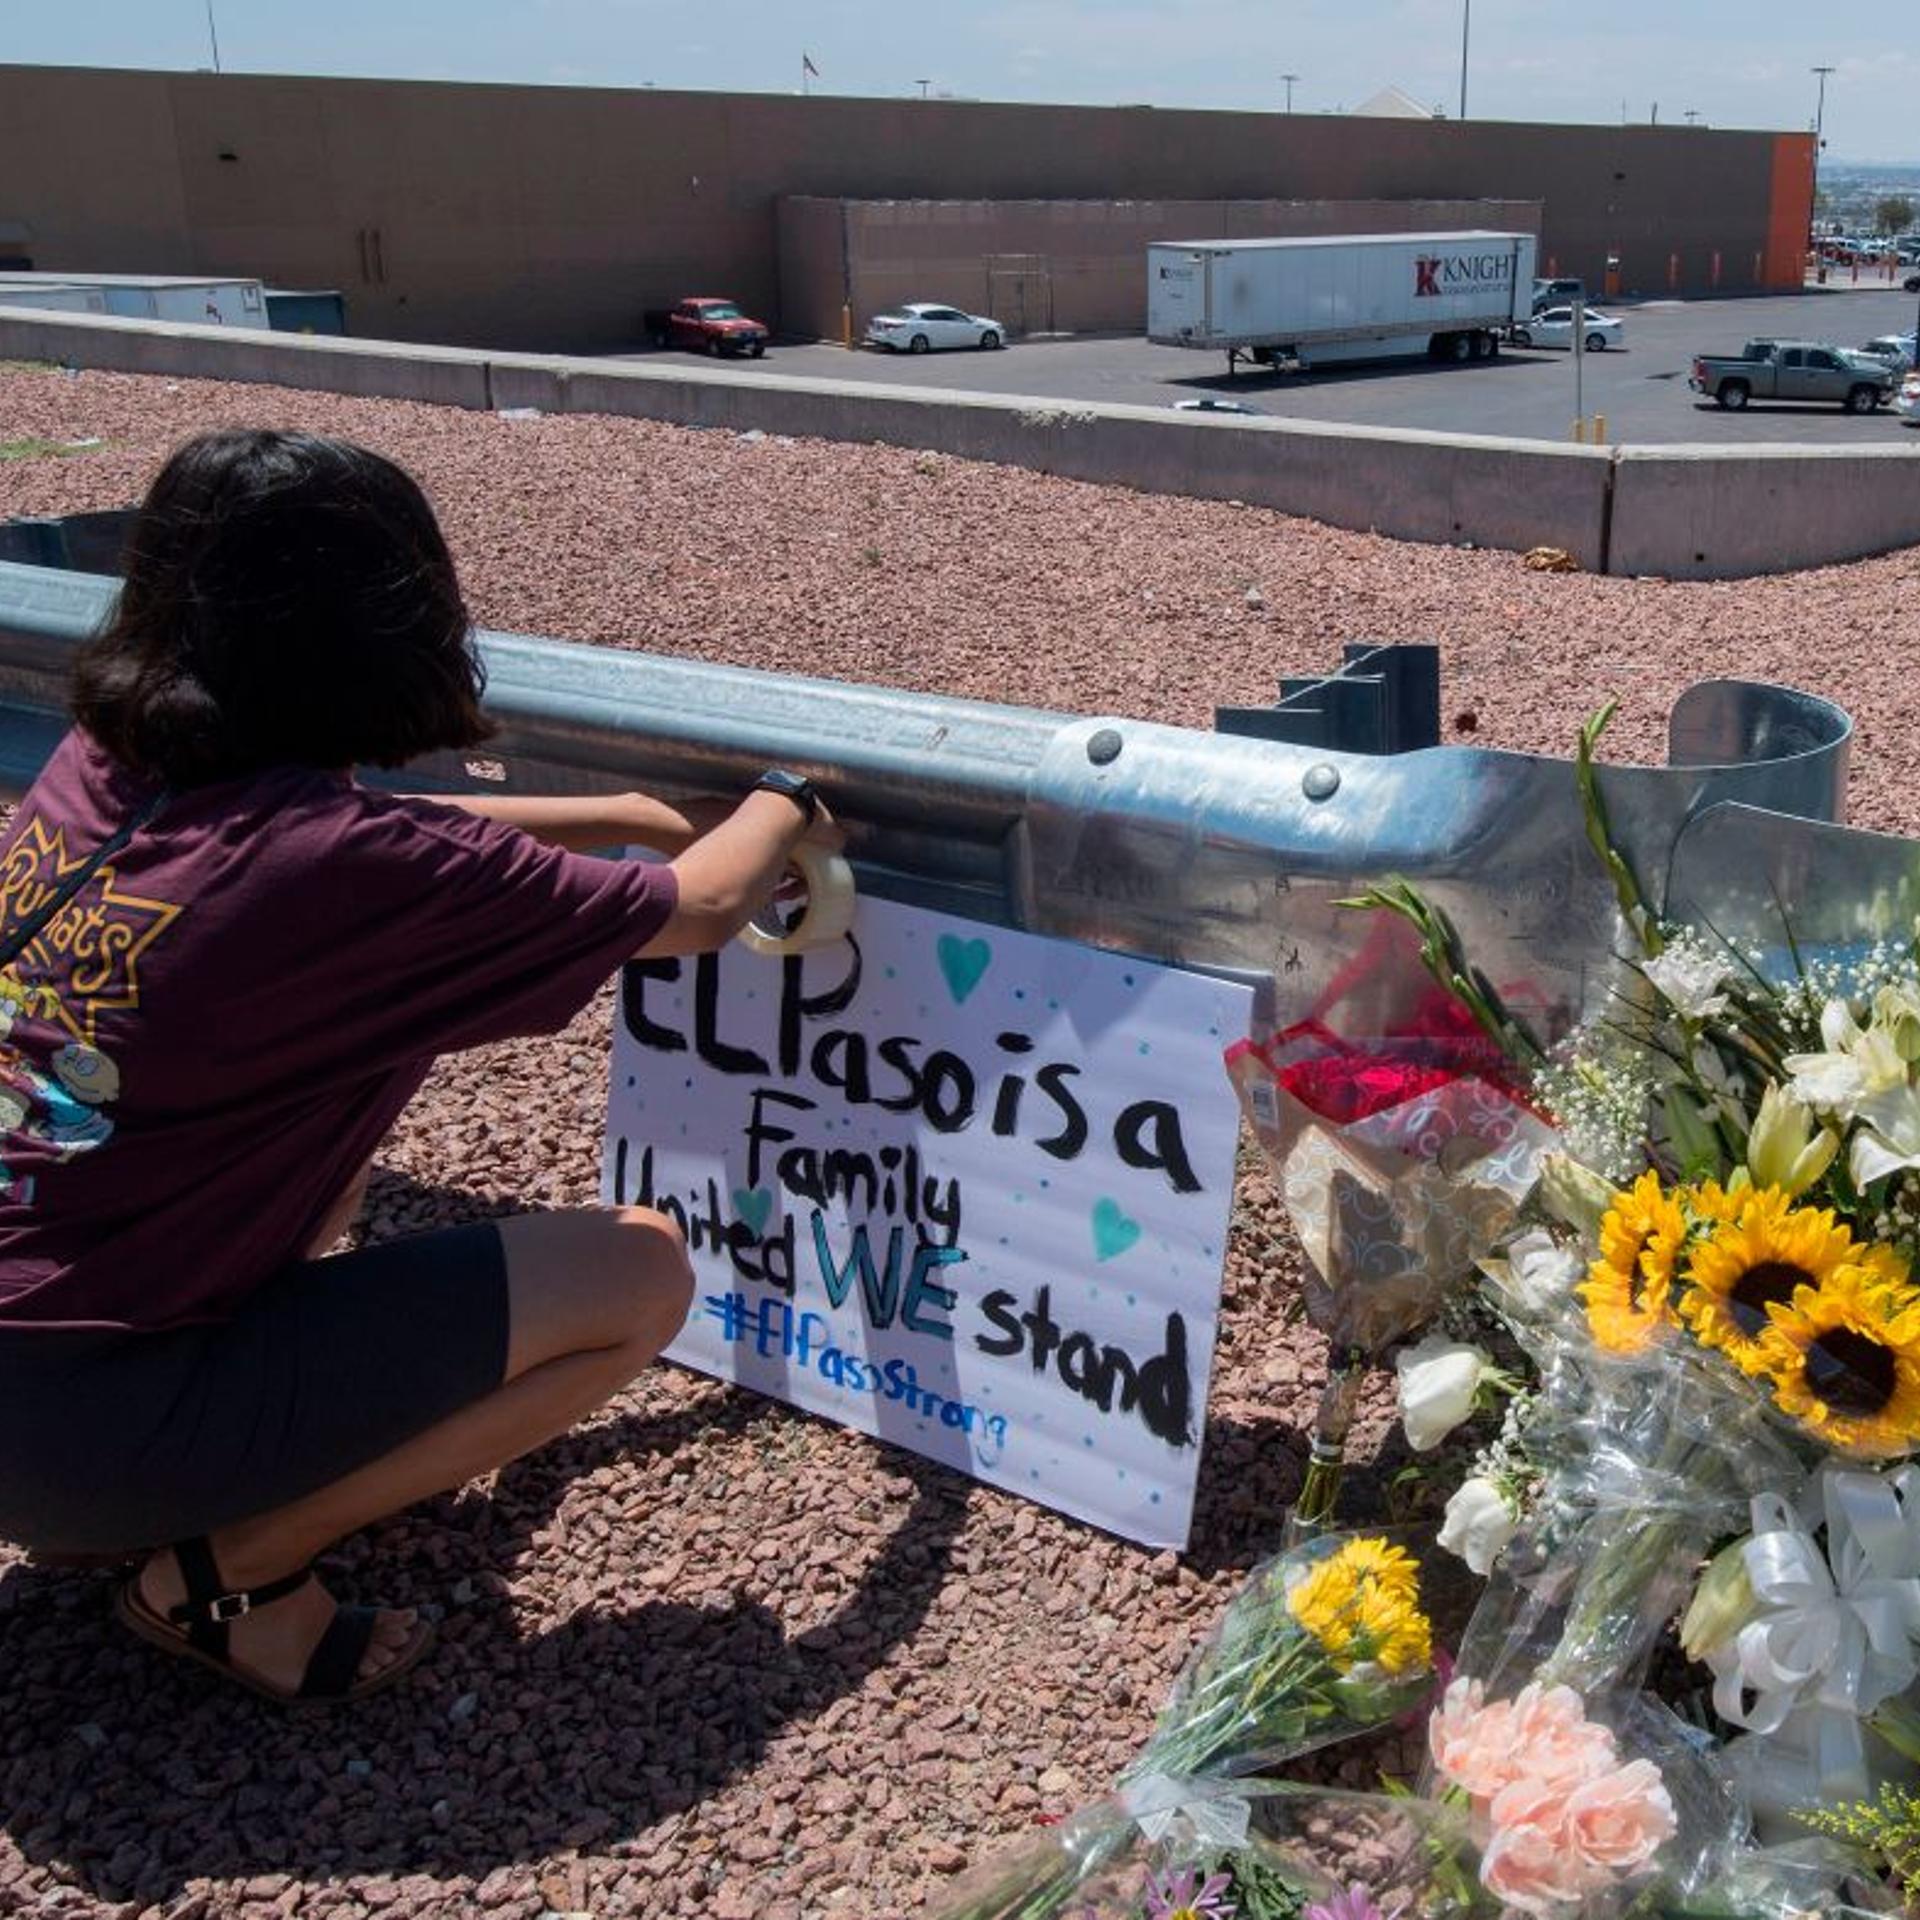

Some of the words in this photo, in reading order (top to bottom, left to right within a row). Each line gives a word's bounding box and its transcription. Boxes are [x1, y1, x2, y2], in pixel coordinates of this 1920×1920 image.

[1443, 254, 1517, 281] KNIGHT
[779, 930, 976, 1133] Paso
[992, 1032, 1089, 1160] is
[1113, 1100, 1206, 1193] a
[614, 1135, 797, 1298] United
[810, 1207, 970, 1341] WE
[743, 1088, 961, 1250] Family
